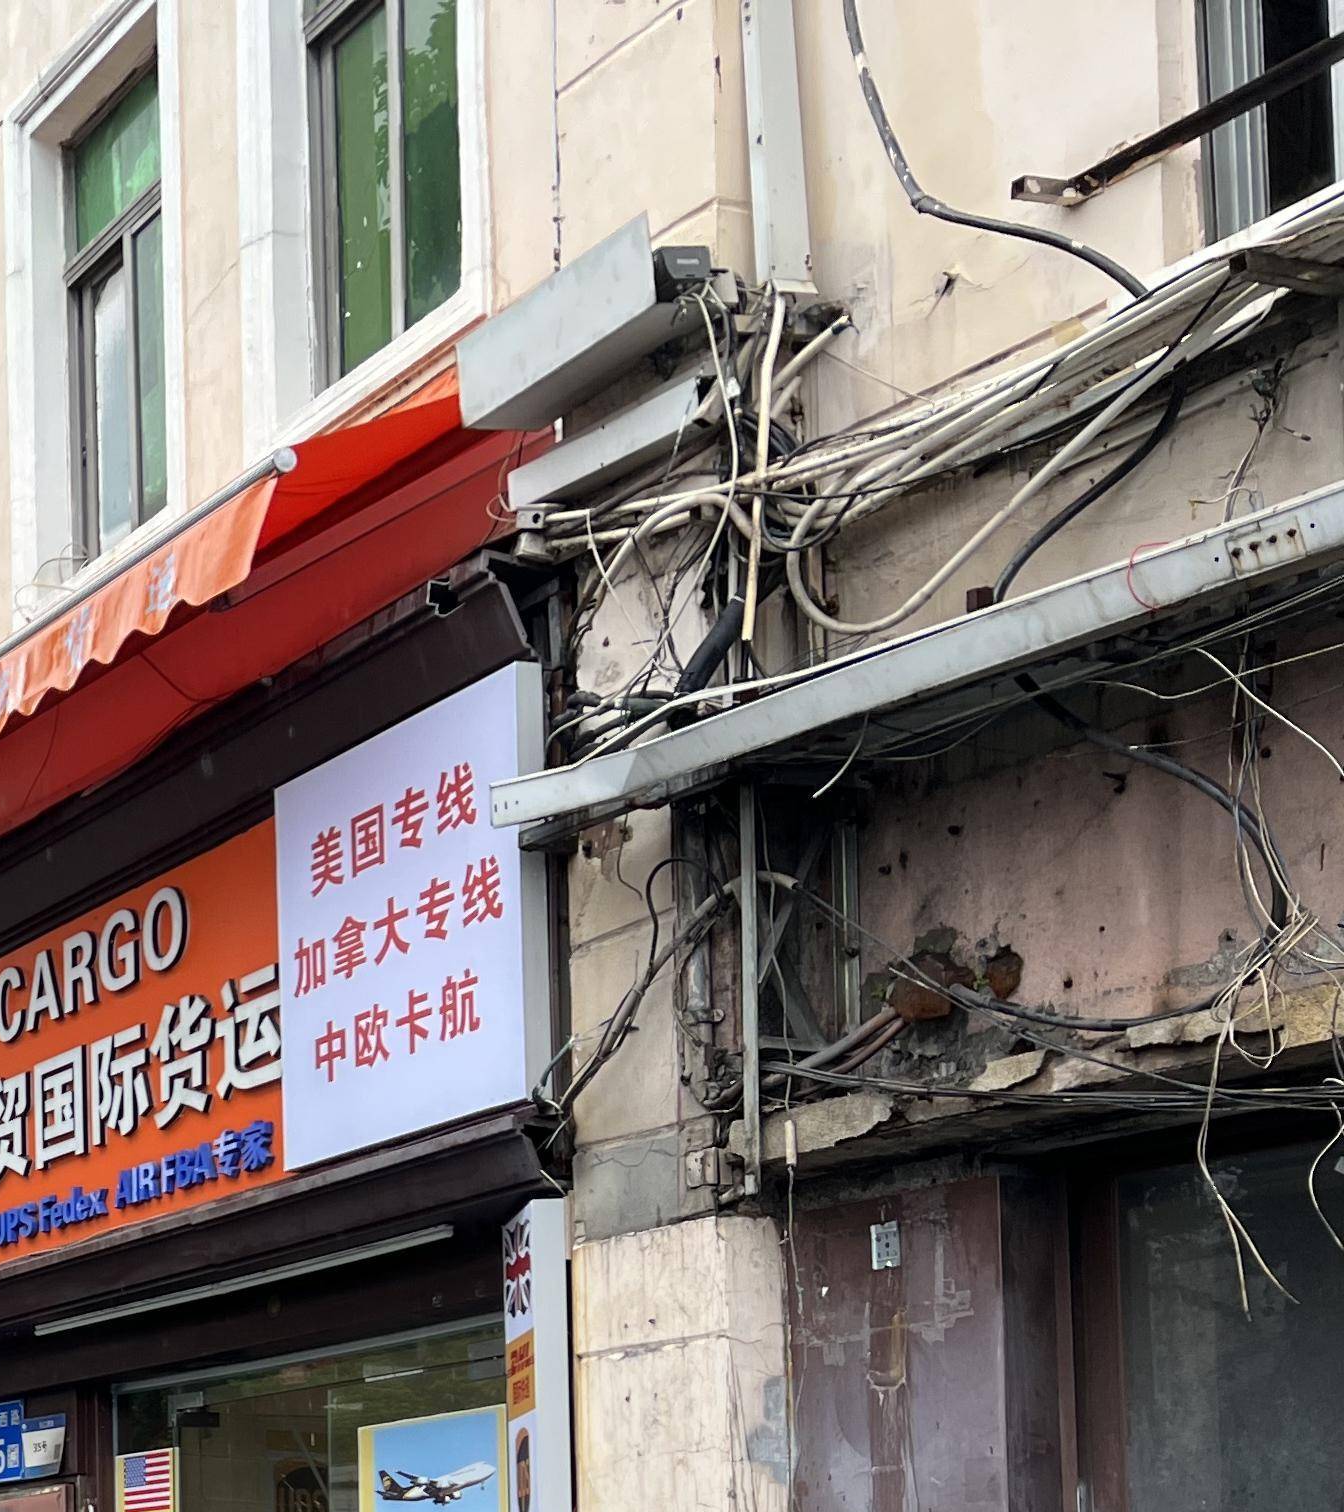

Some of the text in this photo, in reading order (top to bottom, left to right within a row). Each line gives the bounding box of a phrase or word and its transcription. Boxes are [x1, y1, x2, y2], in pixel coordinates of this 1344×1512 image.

[310, 761, 477, 898] 美国专线
[293, 854, 504, 998] 加拿大专线
[314, 968, 481, 1083] 中欧卡航
[38, 1186, 109, 1234] Fedex
[114, 1162, 163, 1209] AIR
